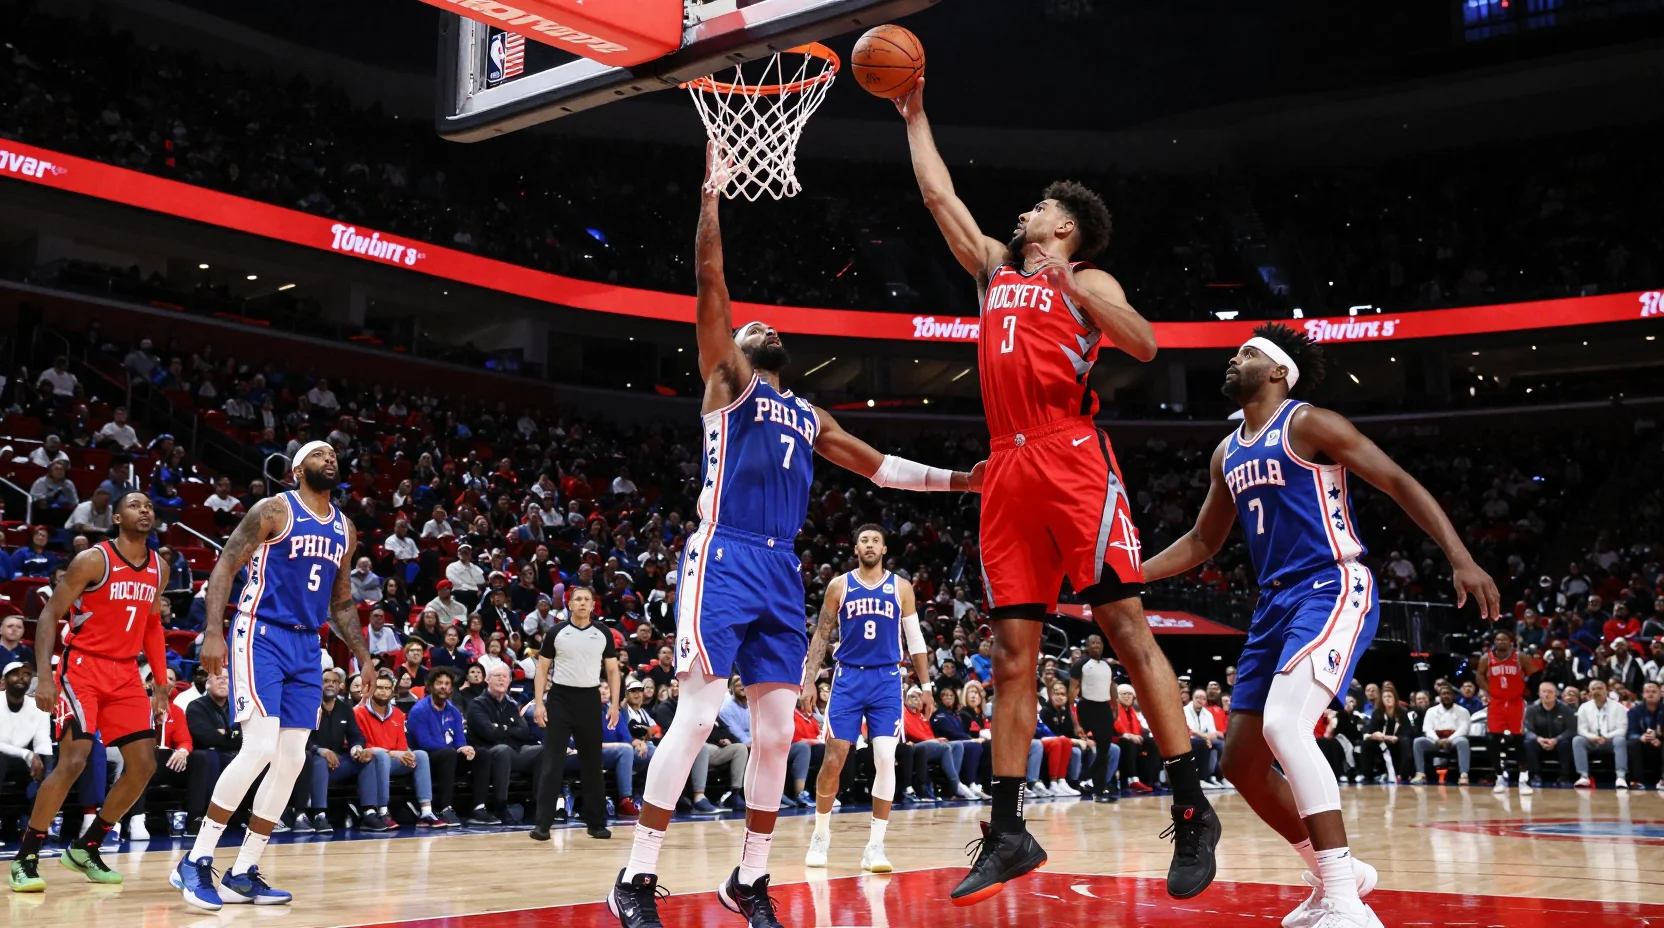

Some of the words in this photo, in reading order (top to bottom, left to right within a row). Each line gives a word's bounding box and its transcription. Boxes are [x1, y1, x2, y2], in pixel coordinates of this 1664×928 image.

[1000, 315, 1017, 354] 3
[754, 397, 815, 447] PHILA
[780, 433, 795, 470] 7
[1225, 458, 1286, 504] PHILA
[1248, 498, 1264, 535] 7
[307, 563, 322, 592] 5
[125, 605, 137, 632] 7
[845, 597, 895, 620] PHILA
[863, 620, 876, 640] 8
